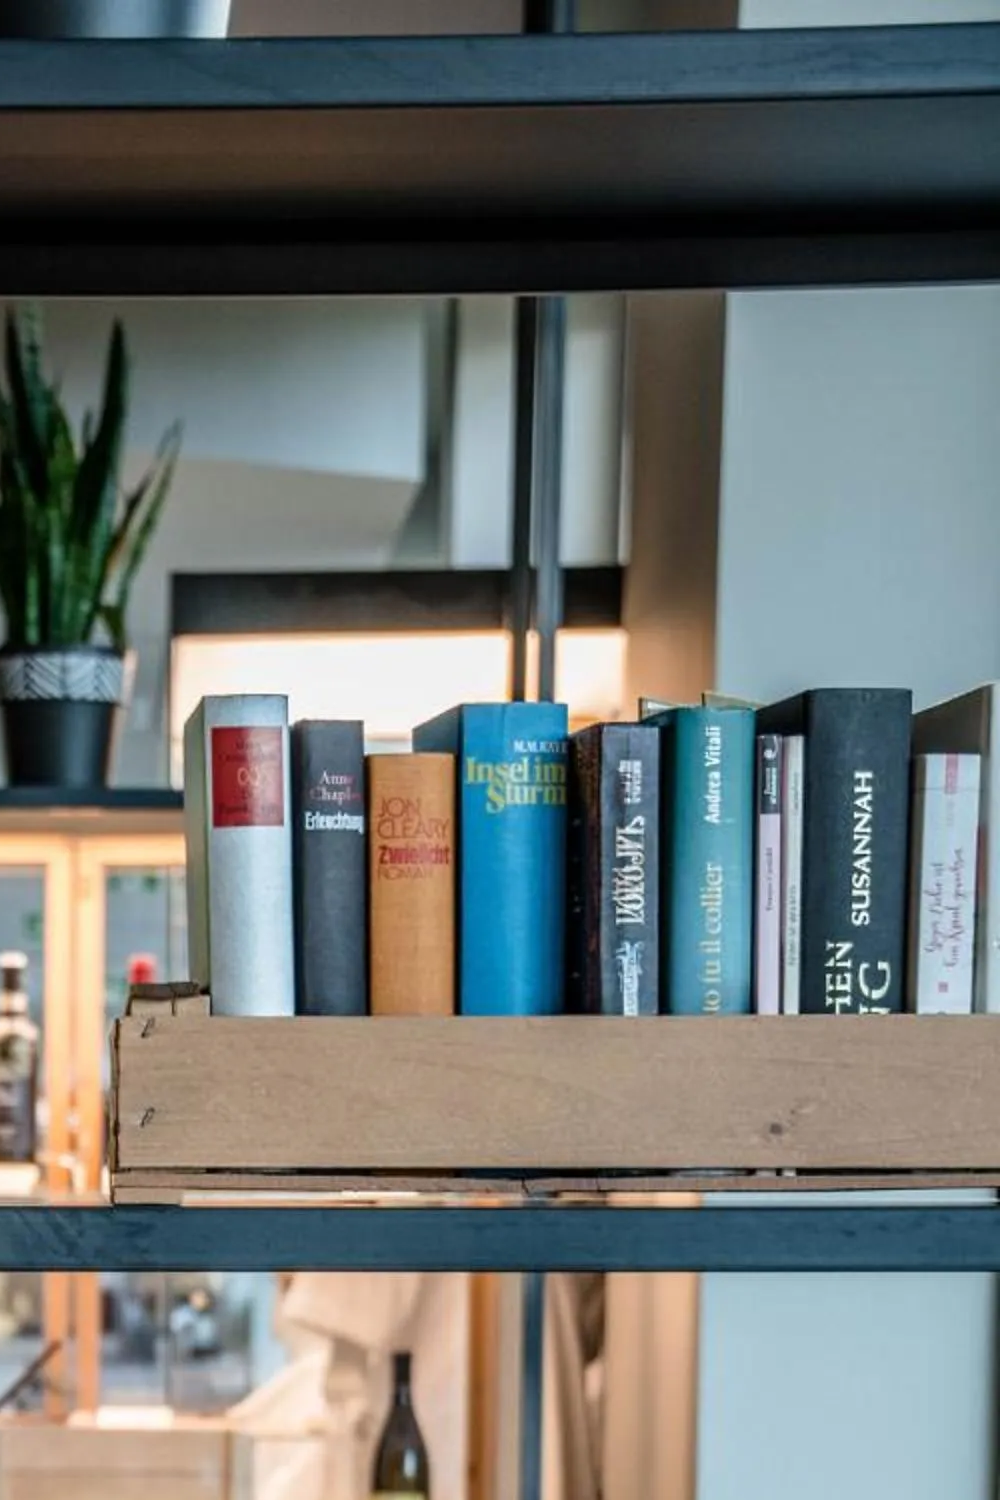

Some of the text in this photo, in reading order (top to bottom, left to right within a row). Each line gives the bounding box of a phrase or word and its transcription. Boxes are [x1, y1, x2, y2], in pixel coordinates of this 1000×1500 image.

[466, 757, 566, 784] Insel im
[703, 726, 722, 824] Andrea Vitali
[377, 797, 421, 818] JON
[486, 783, 566, 815] Sturm
[378, 818, 450, 839] CLEARY
[851, 771, 875, 927] SUSANNAH
[700, 863, 724, 935] collier
